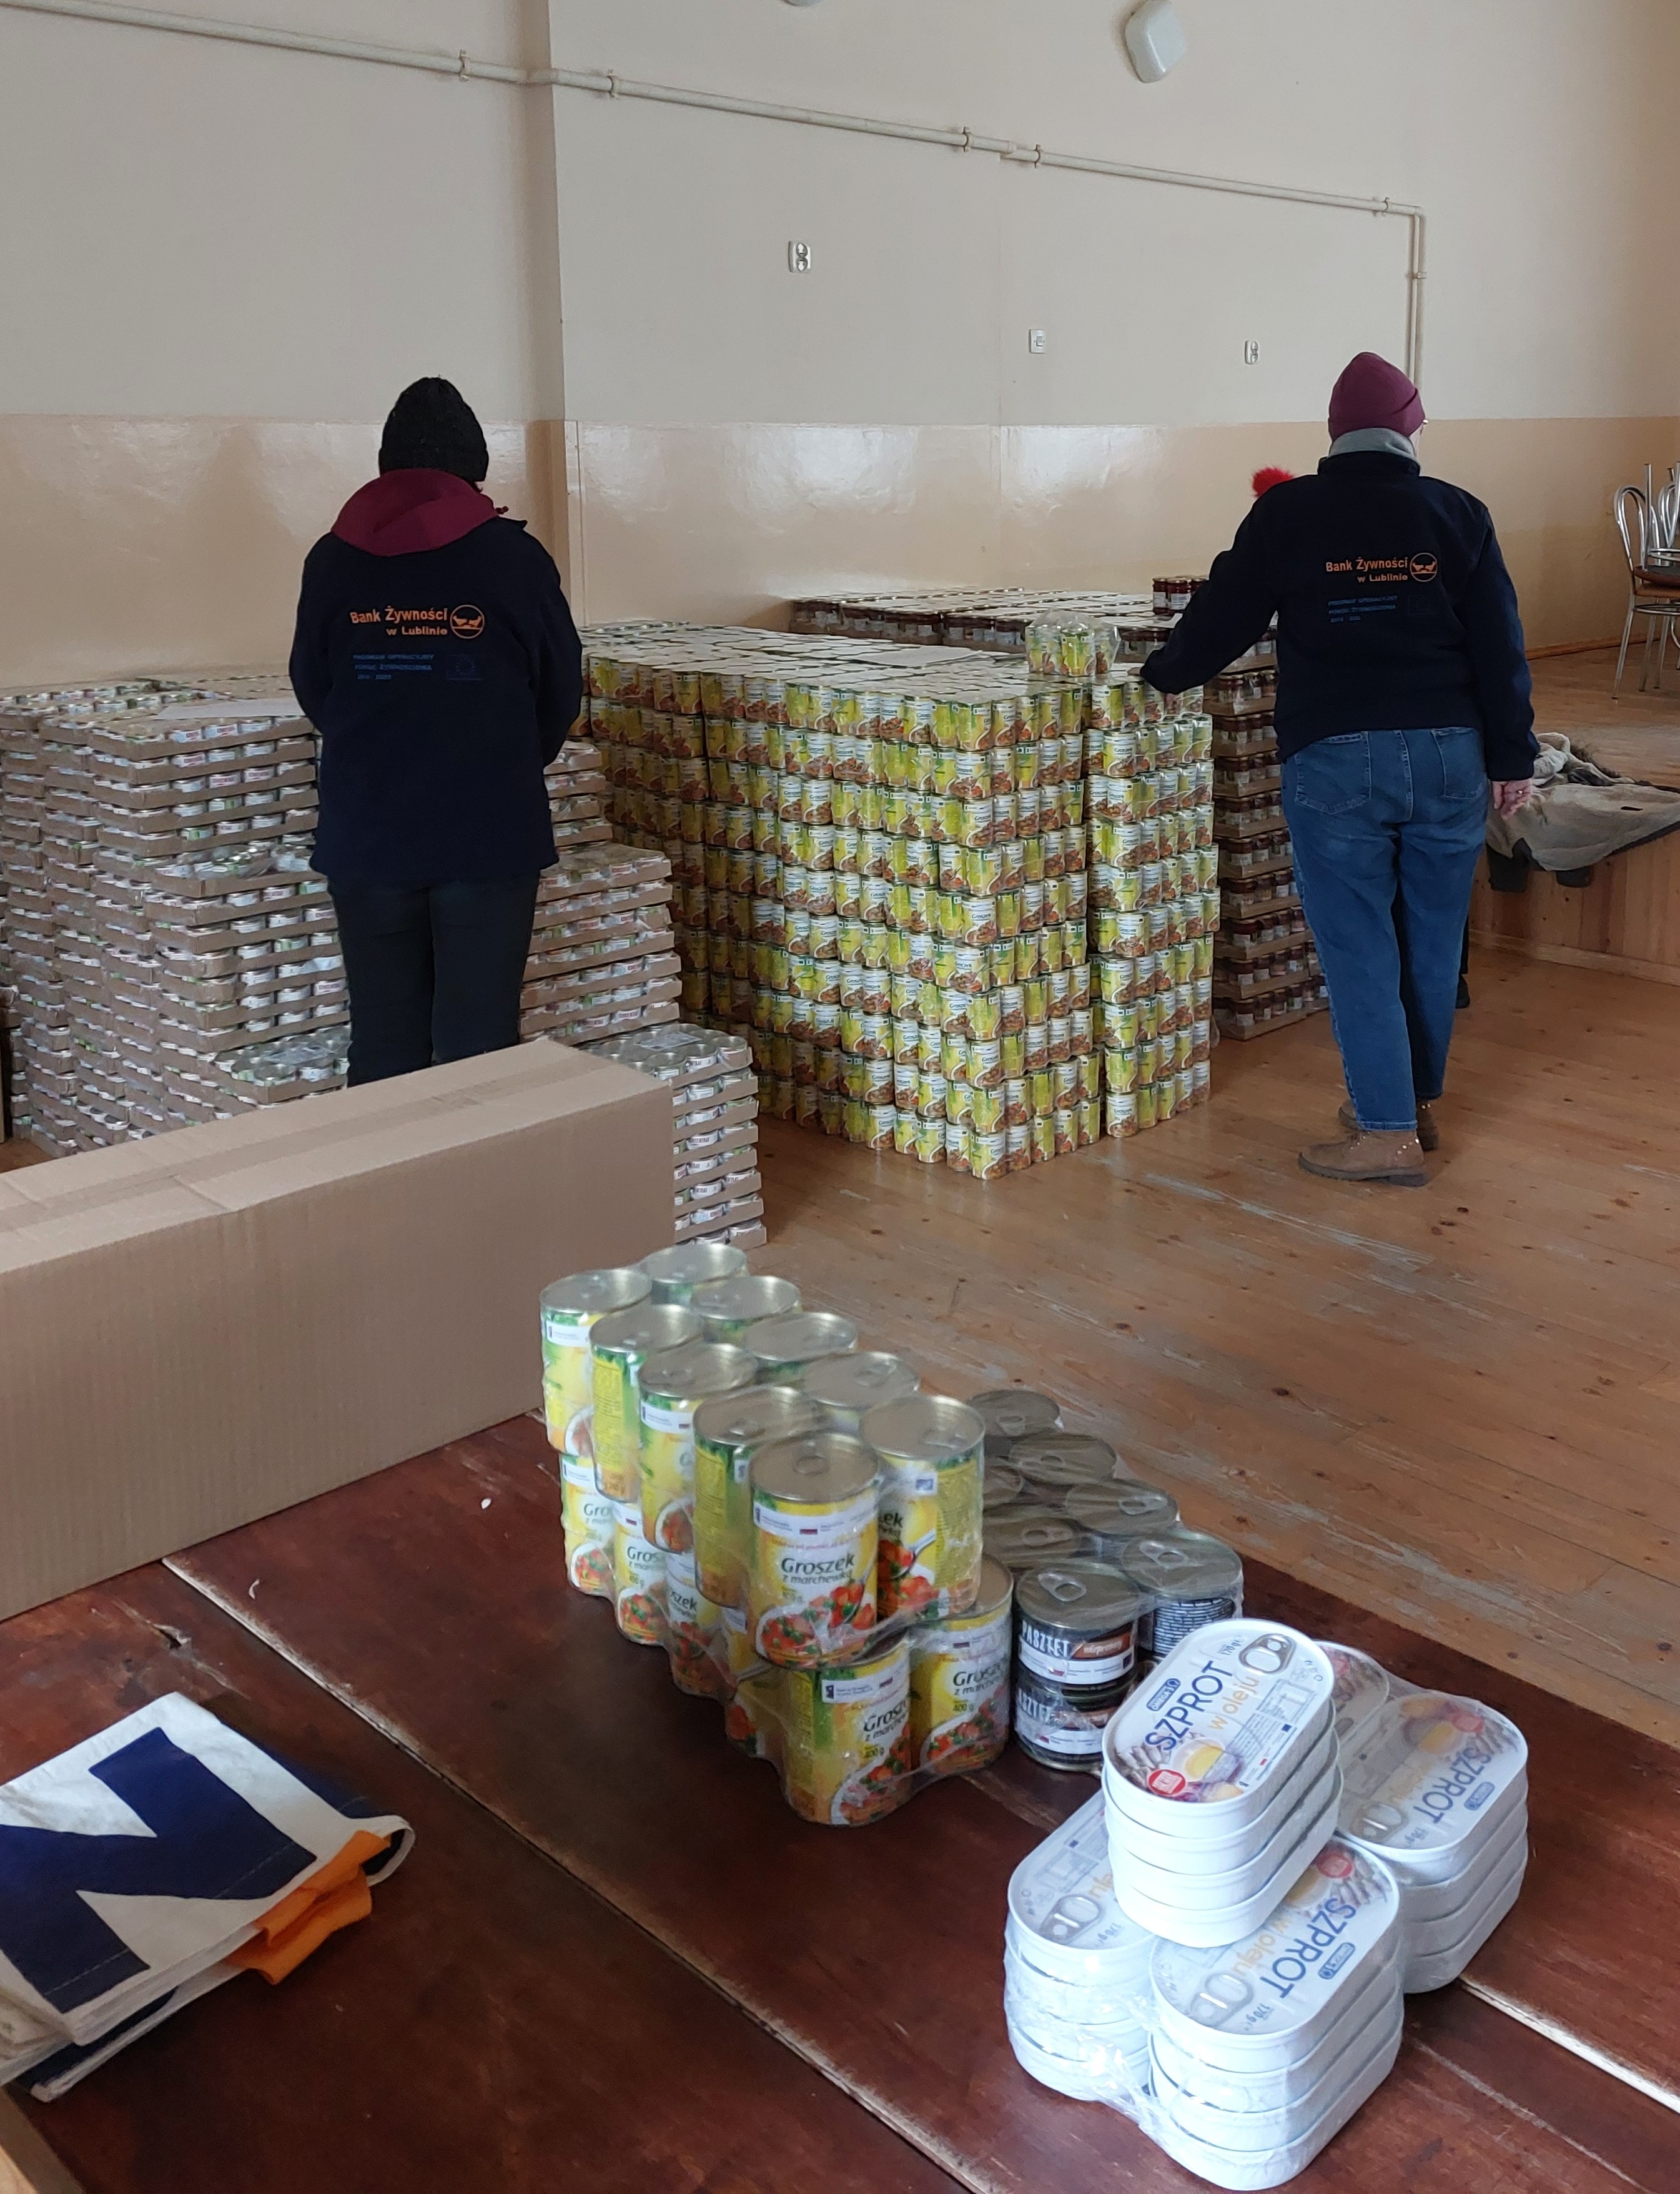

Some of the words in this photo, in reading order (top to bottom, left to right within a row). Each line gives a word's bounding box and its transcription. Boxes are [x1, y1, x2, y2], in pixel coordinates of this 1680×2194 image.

[1326, 560, 1353, 572] Bank
[1356, 557, 1408, 572] Żywności
[1369, 573, 1408, 582] Lublinie
[350, 609, 381, 624] Bank
[385, 605, 448, 623] Żywności
[402, 626, 448, 636] Lublinie
[781, 1553, 854, 1574] Groszek
[1022, 1619, 1070, 1658] PASZTET
[1145, 1661, 1233, 1751] SZPROT
[1207, 1715, 1228, 1730] w
[1222, 1676, 1260, 1714] oleju
[1413, 1746, 1492, 1824] SZPROT
[1260, 1897, 1356, 1999] SZPROT
